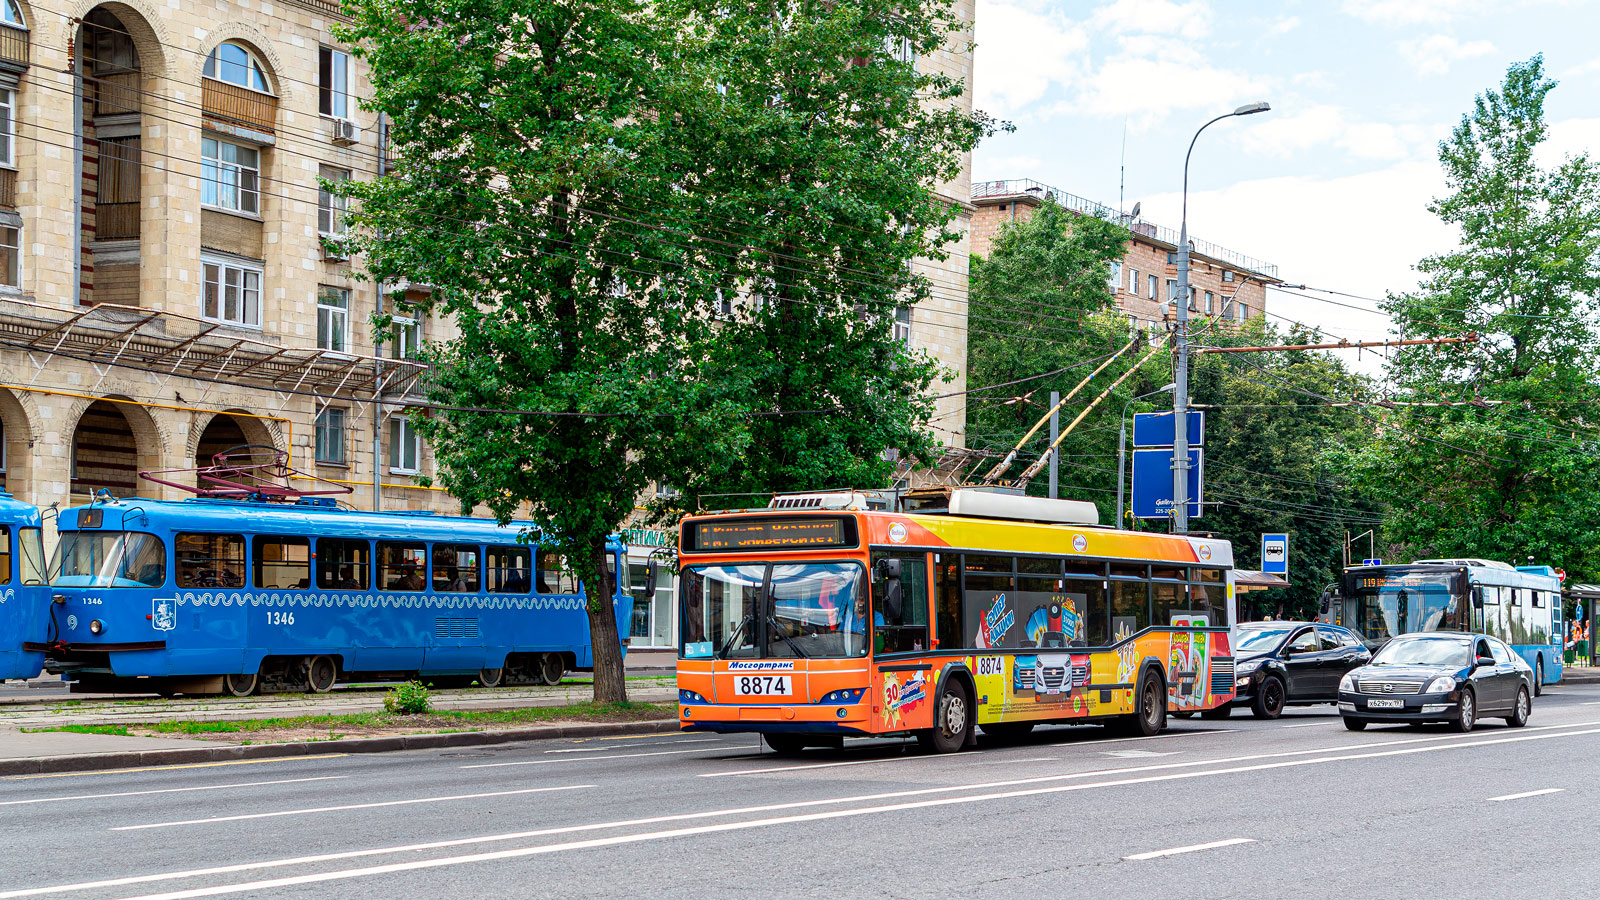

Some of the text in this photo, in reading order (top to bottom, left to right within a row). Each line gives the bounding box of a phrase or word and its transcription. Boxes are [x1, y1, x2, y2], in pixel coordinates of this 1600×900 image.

[621, 527, 665, 546] ОПТИКА
[1363, 578, 1376, 588] 119
[82, 597, 103, 605] 1346
[266, 611, 295, 626] 1346
[728, 661, 794, 670] Мосгортранс
[980, 656, 1002, 675] 8874
[740, 676, 786, 695] 8874
[886, 683, 898, 706] 30
